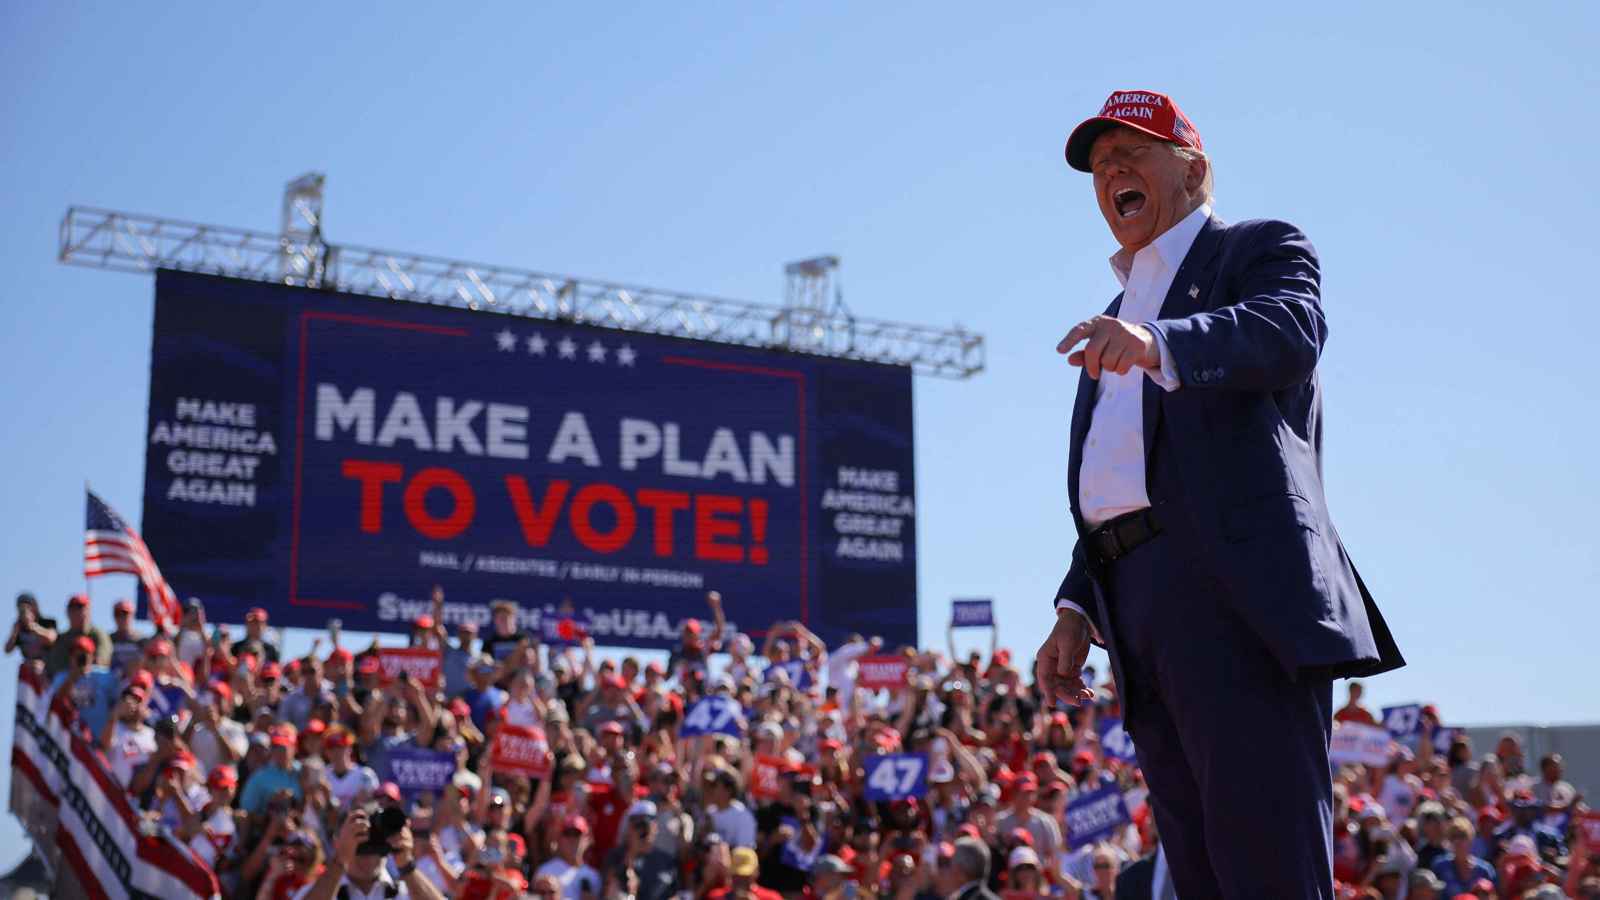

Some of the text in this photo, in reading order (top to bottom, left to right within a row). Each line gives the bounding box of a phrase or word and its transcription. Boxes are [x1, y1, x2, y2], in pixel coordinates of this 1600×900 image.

[1107, 93, 1163, 107] AMERICA
[1113, 106, 1153, 120] AGAIN
[175, 397, 256, 427] MAKE
[151, 421, 277, 455] AMERICA
[315, 382, 796, 488] MAKE A PLAN
[166, 450, 260, 479] GREAT
[837, 465, 898, 491] MAKE
[167, 477, 256, 507] AGAIN
[821, 489, 914, 517] AMERICA
[342, 460, 768, 565] TO VOTE!
[833, 513, 903, 537] GREAT
[419, 550, 460, 570] MAIL
[835, 538, 903, 562] AGAIN
[684, 698, 733, 733] 47
[868, 757, 925, 795] 47
